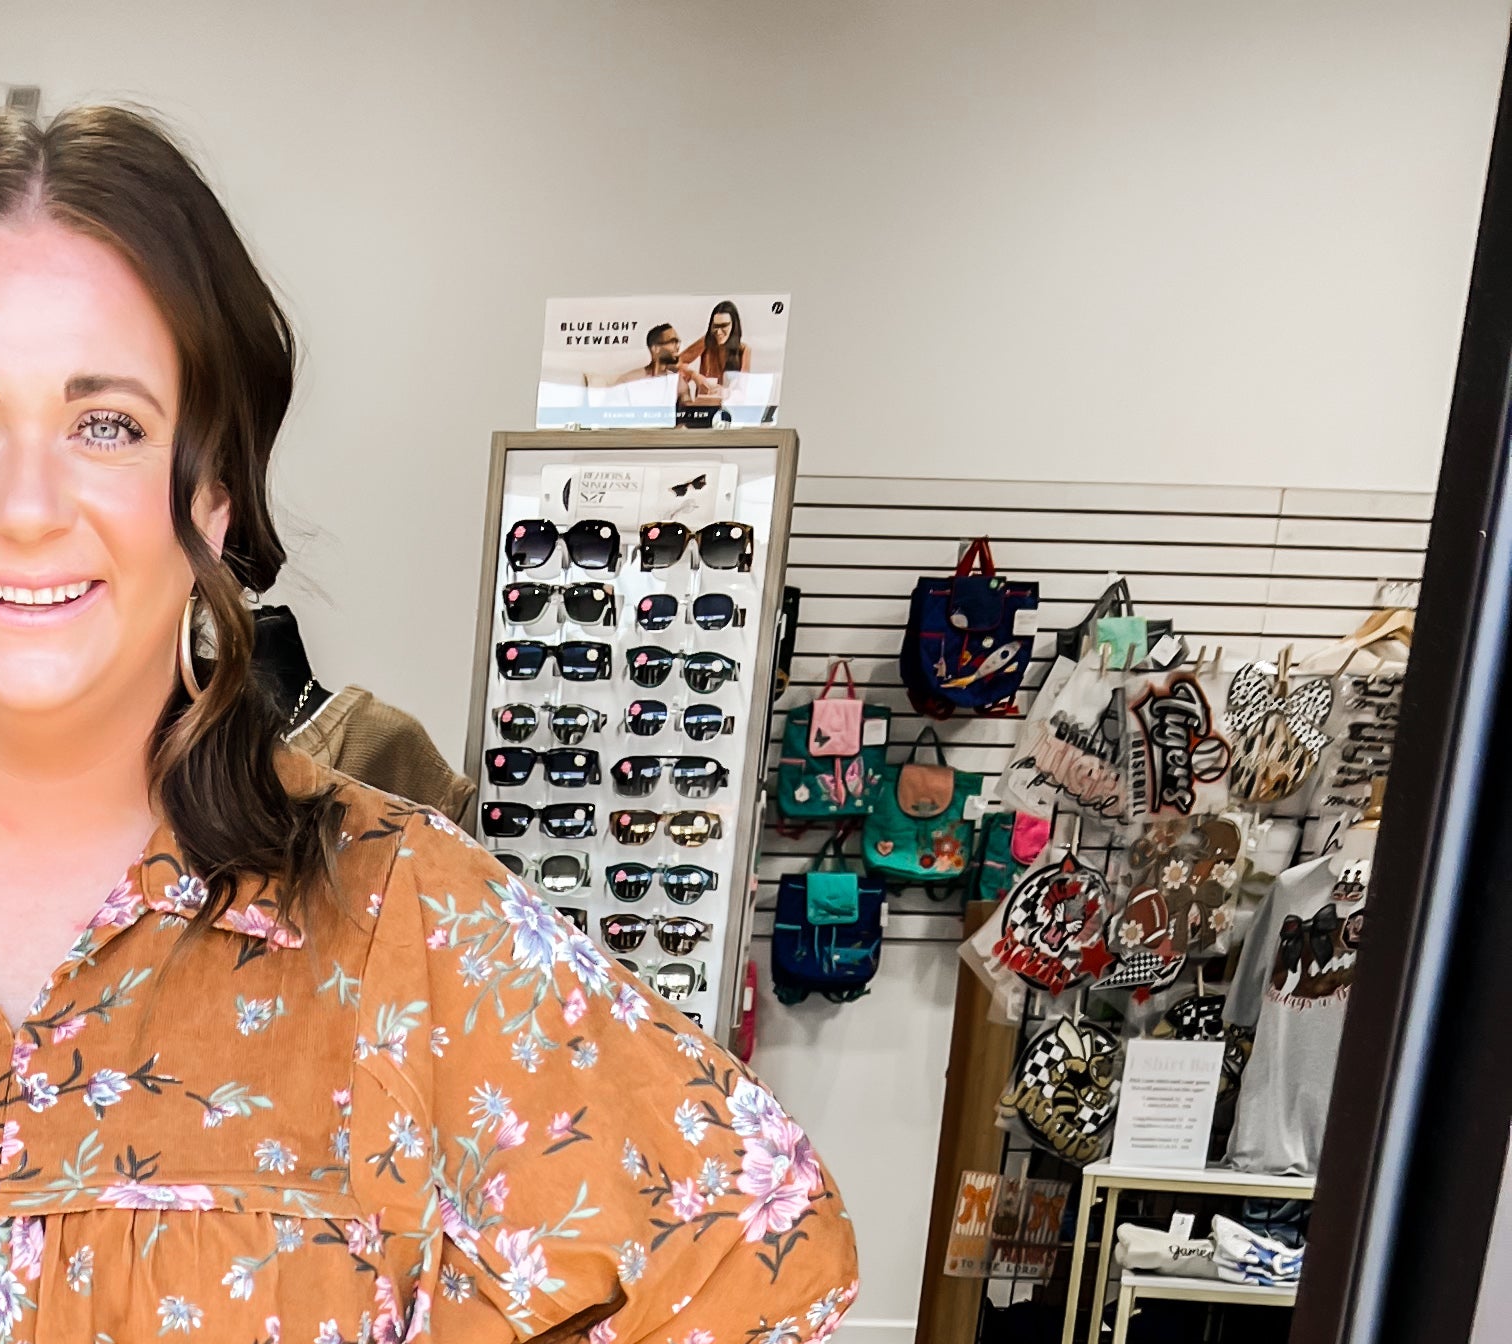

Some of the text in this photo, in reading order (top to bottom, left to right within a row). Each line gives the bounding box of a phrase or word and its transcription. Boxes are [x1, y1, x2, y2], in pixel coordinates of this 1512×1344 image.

[560, 321, 638, 331] BLUE LIGHT
[566, 335, 630, 345] EYEWEAR
